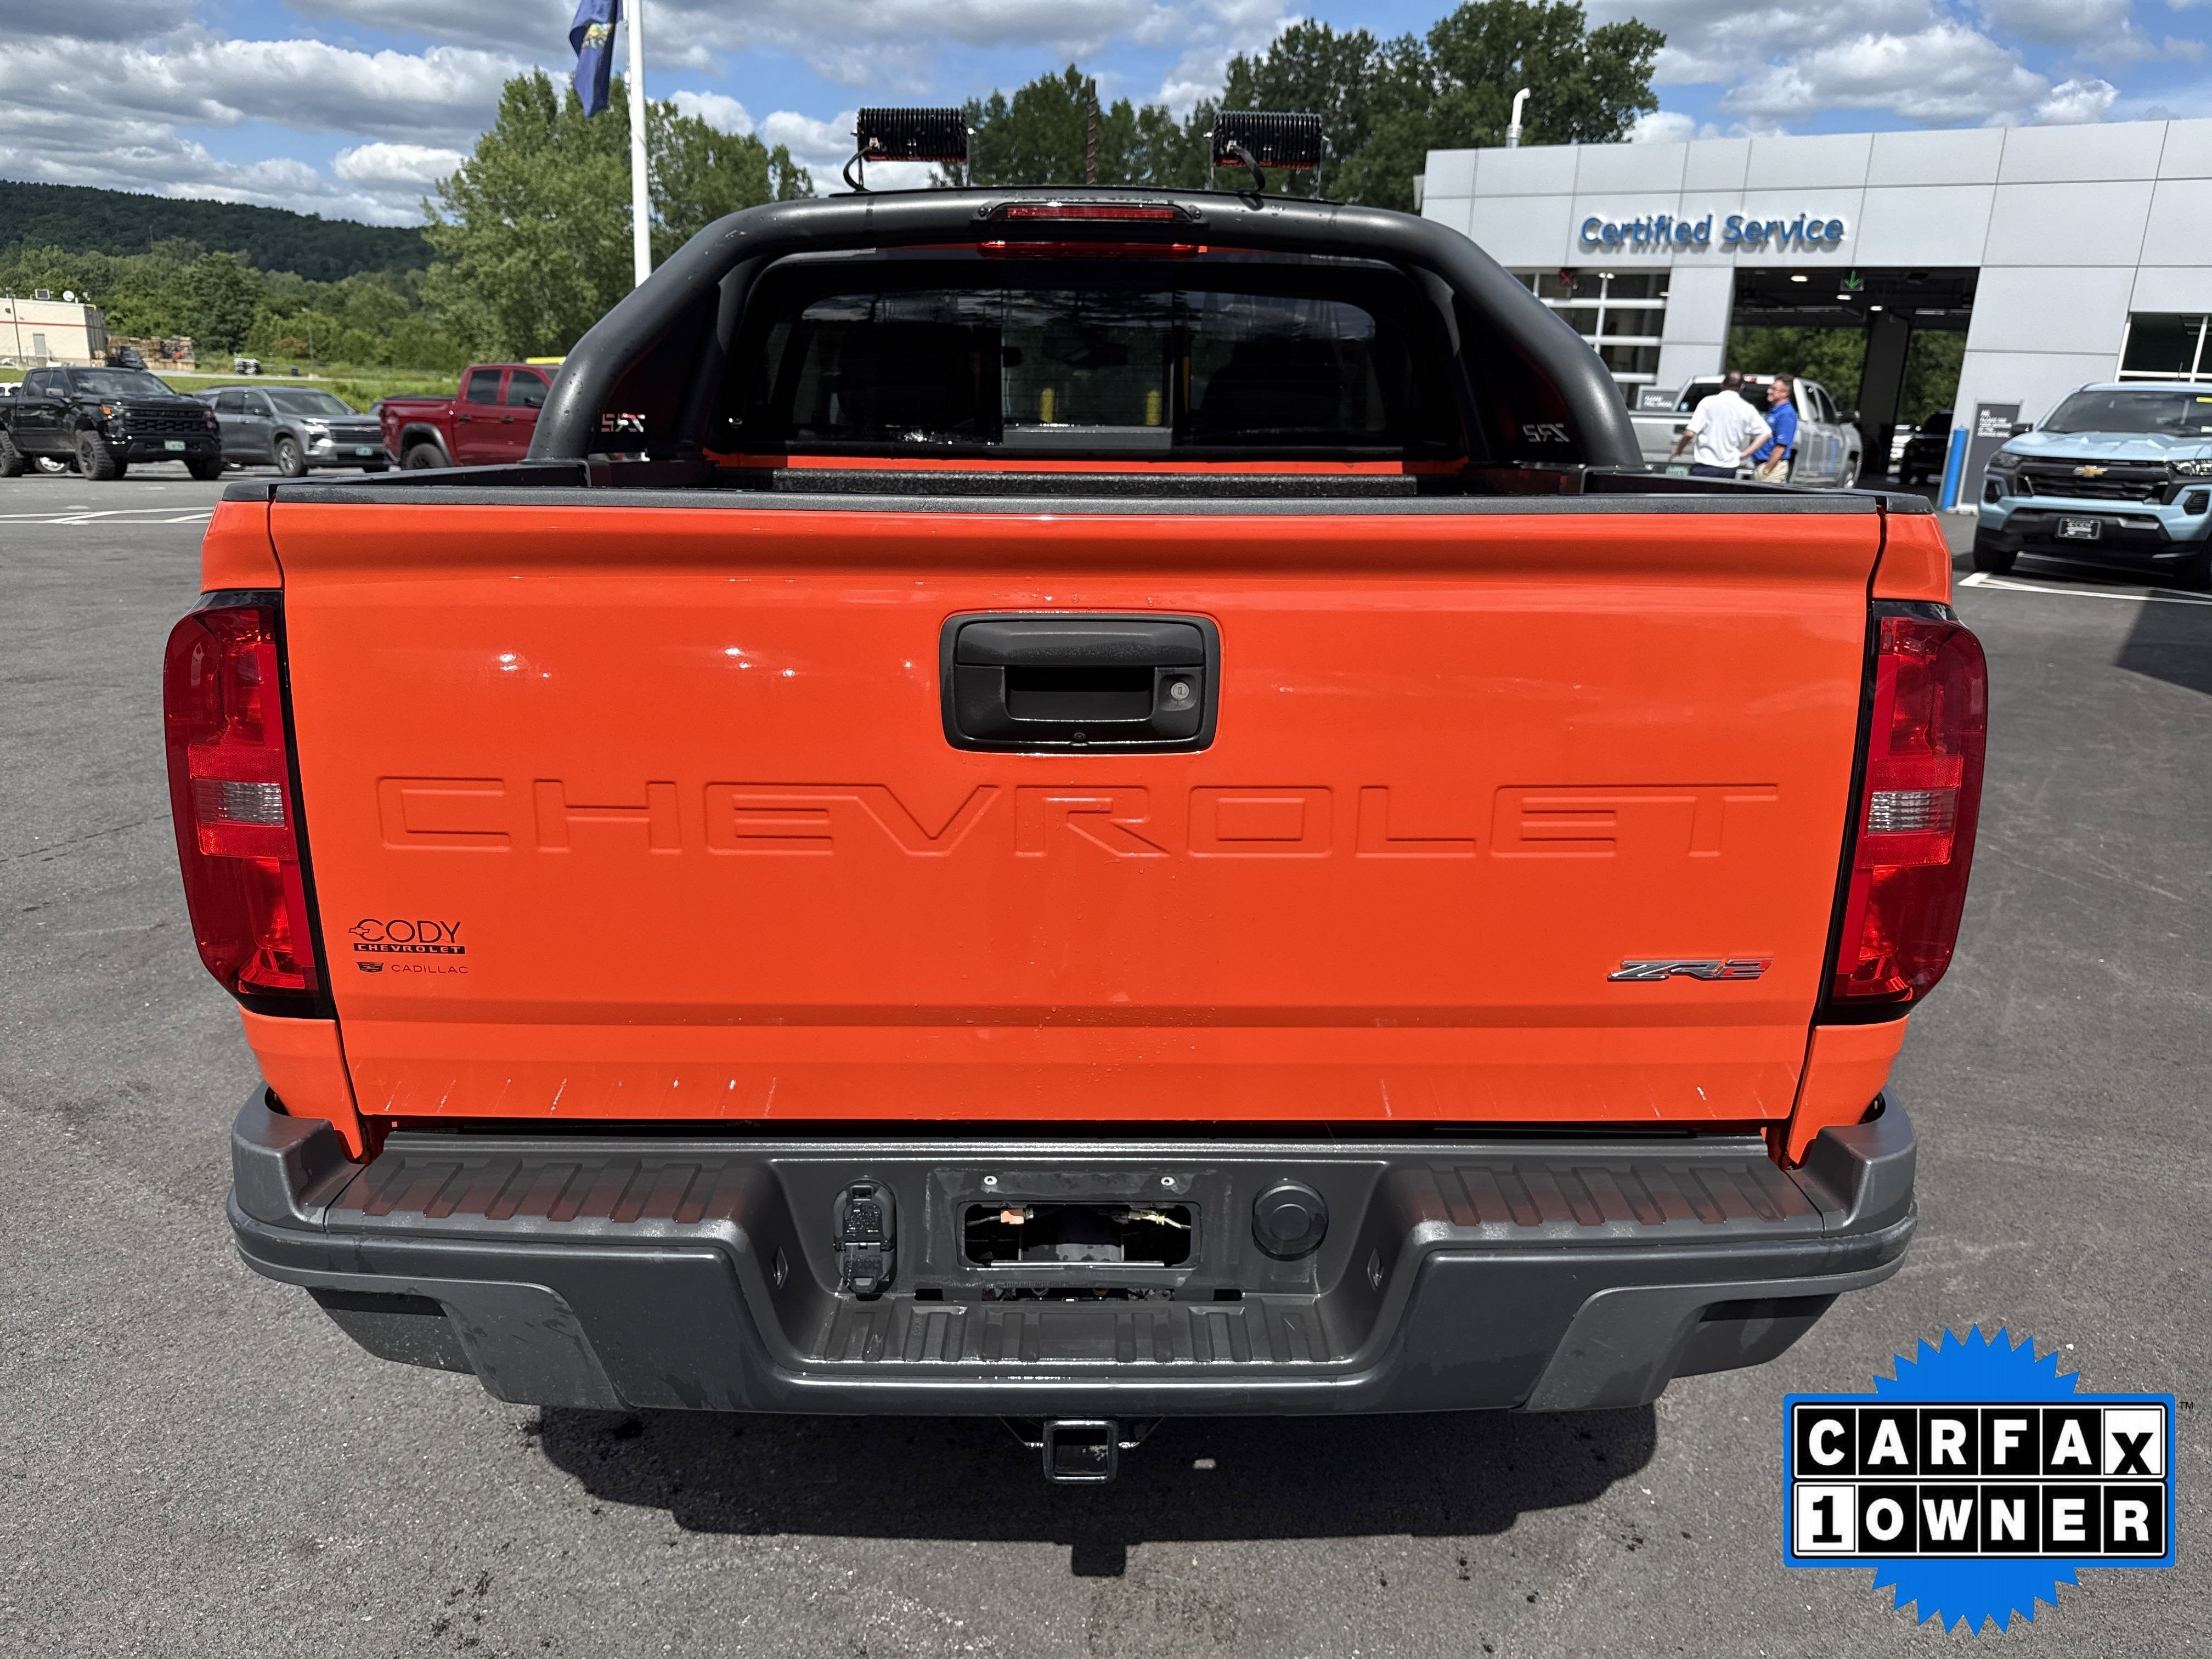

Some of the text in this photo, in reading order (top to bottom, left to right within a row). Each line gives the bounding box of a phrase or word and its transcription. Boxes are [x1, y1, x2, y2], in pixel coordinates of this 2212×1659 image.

[1580, 212, 1844, 244] Certified Service
[376, 775, 1779, 859] CHEVROLET
[356, 918, 461, 944] CODY
[358, 944, 461, 953] CHEVROLET
[391, 964, 469, 974] CADILLAC
[1607, 959, 1774, 981] ZR2
